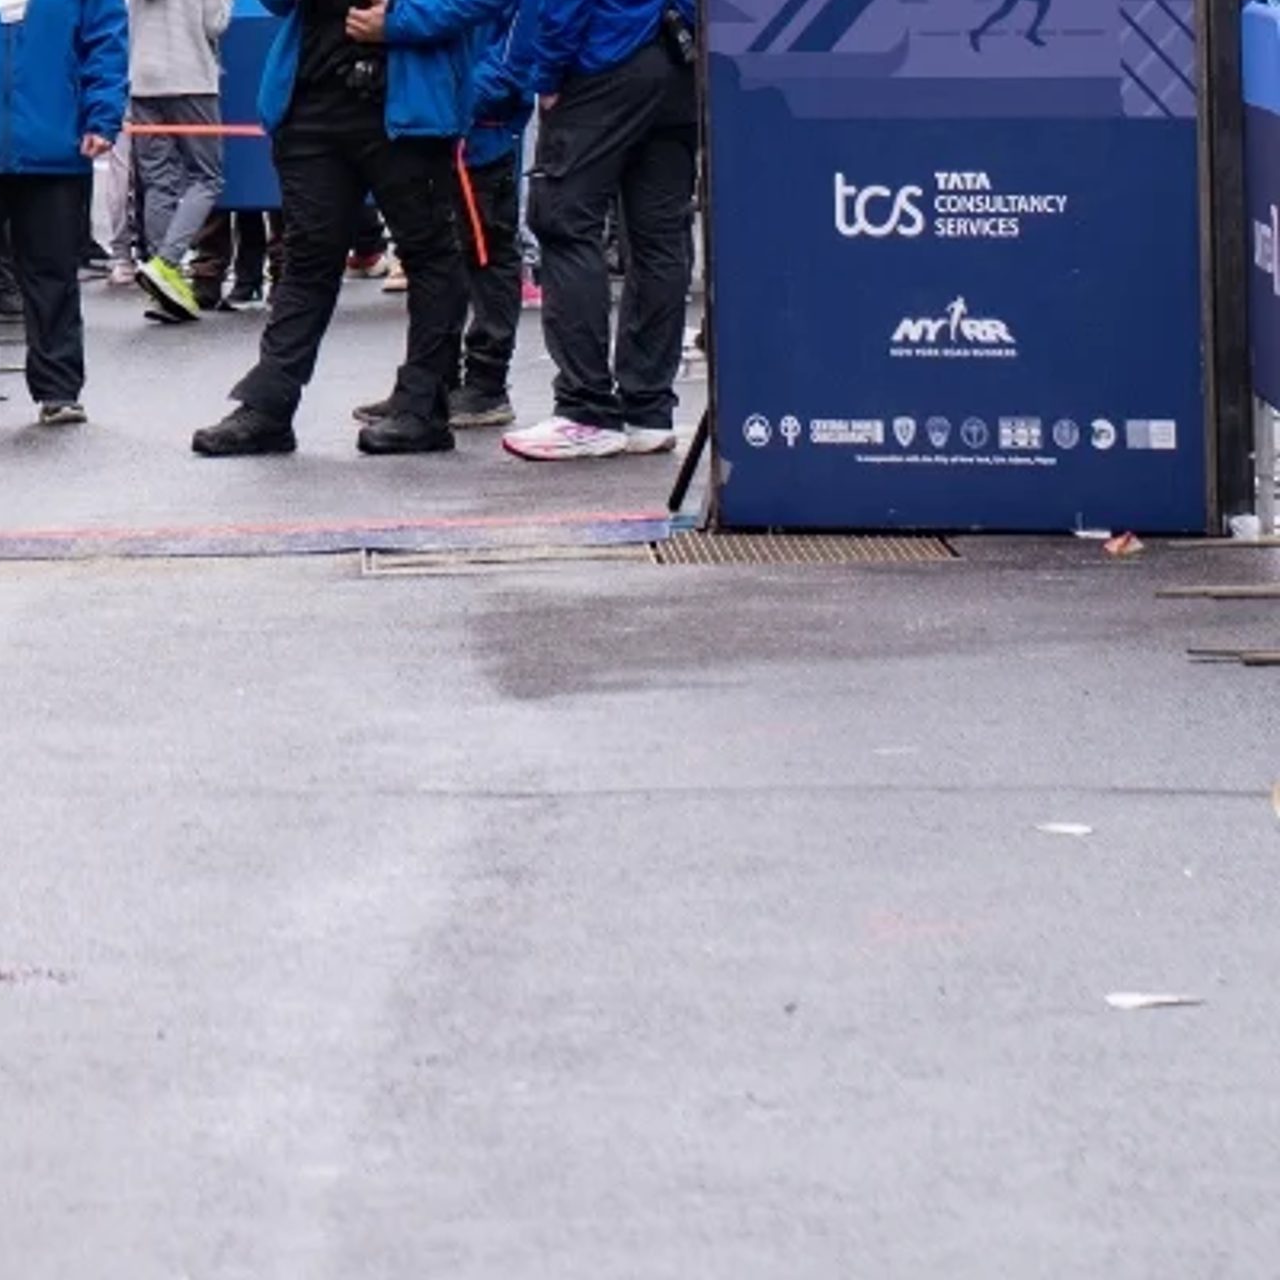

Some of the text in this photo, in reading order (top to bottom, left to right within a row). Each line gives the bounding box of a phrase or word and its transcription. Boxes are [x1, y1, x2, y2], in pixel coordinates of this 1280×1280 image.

[934, 172, 992, 190] TATA
[835, 171, 925, 237] tcs
[934, 194, 1068, 214] CONSULTANCY
[934, 217, 1020, 237] SERVICES
